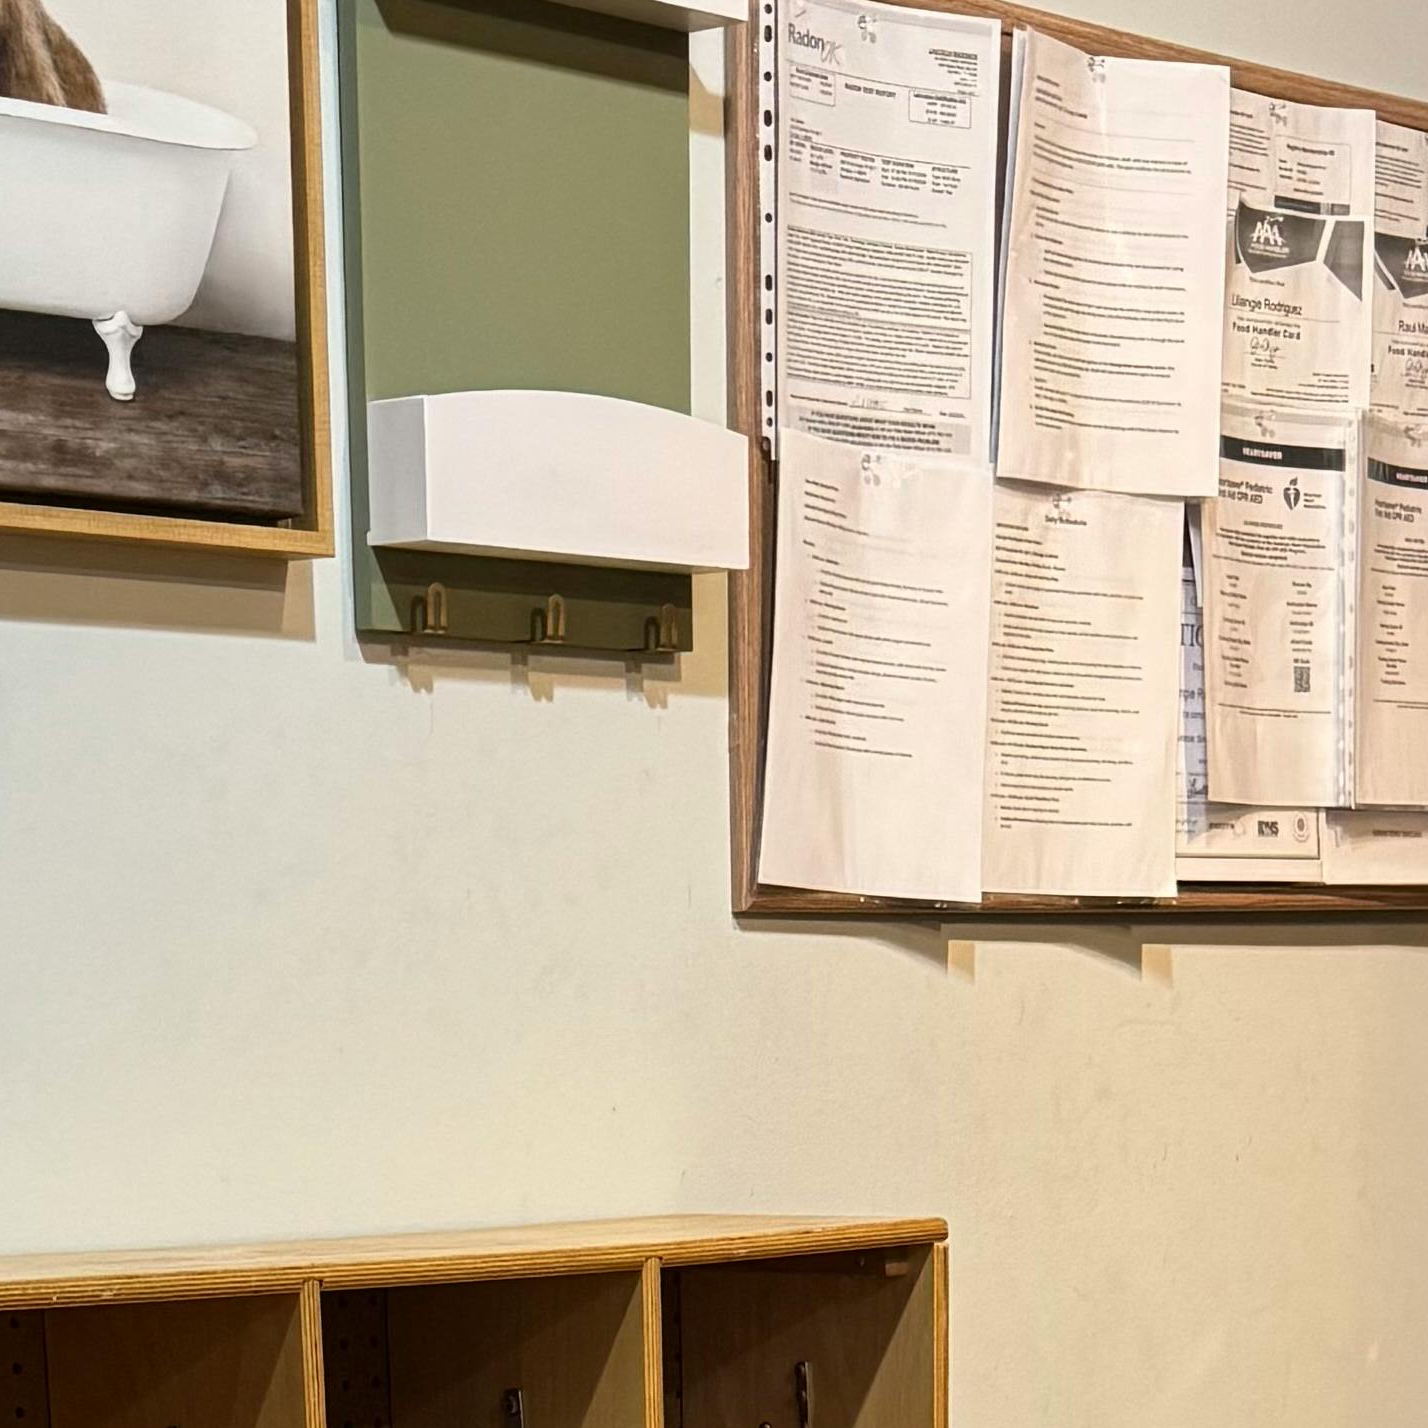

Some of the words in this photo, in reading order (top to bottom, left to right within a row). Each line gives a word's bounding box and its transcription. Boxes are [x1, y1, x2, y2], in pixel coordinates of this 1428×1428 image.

[1232, 322, 1250, 334] Food
[1252, 325, 1281, 338] Handler
[1283, 328, 1301, 340] Card
